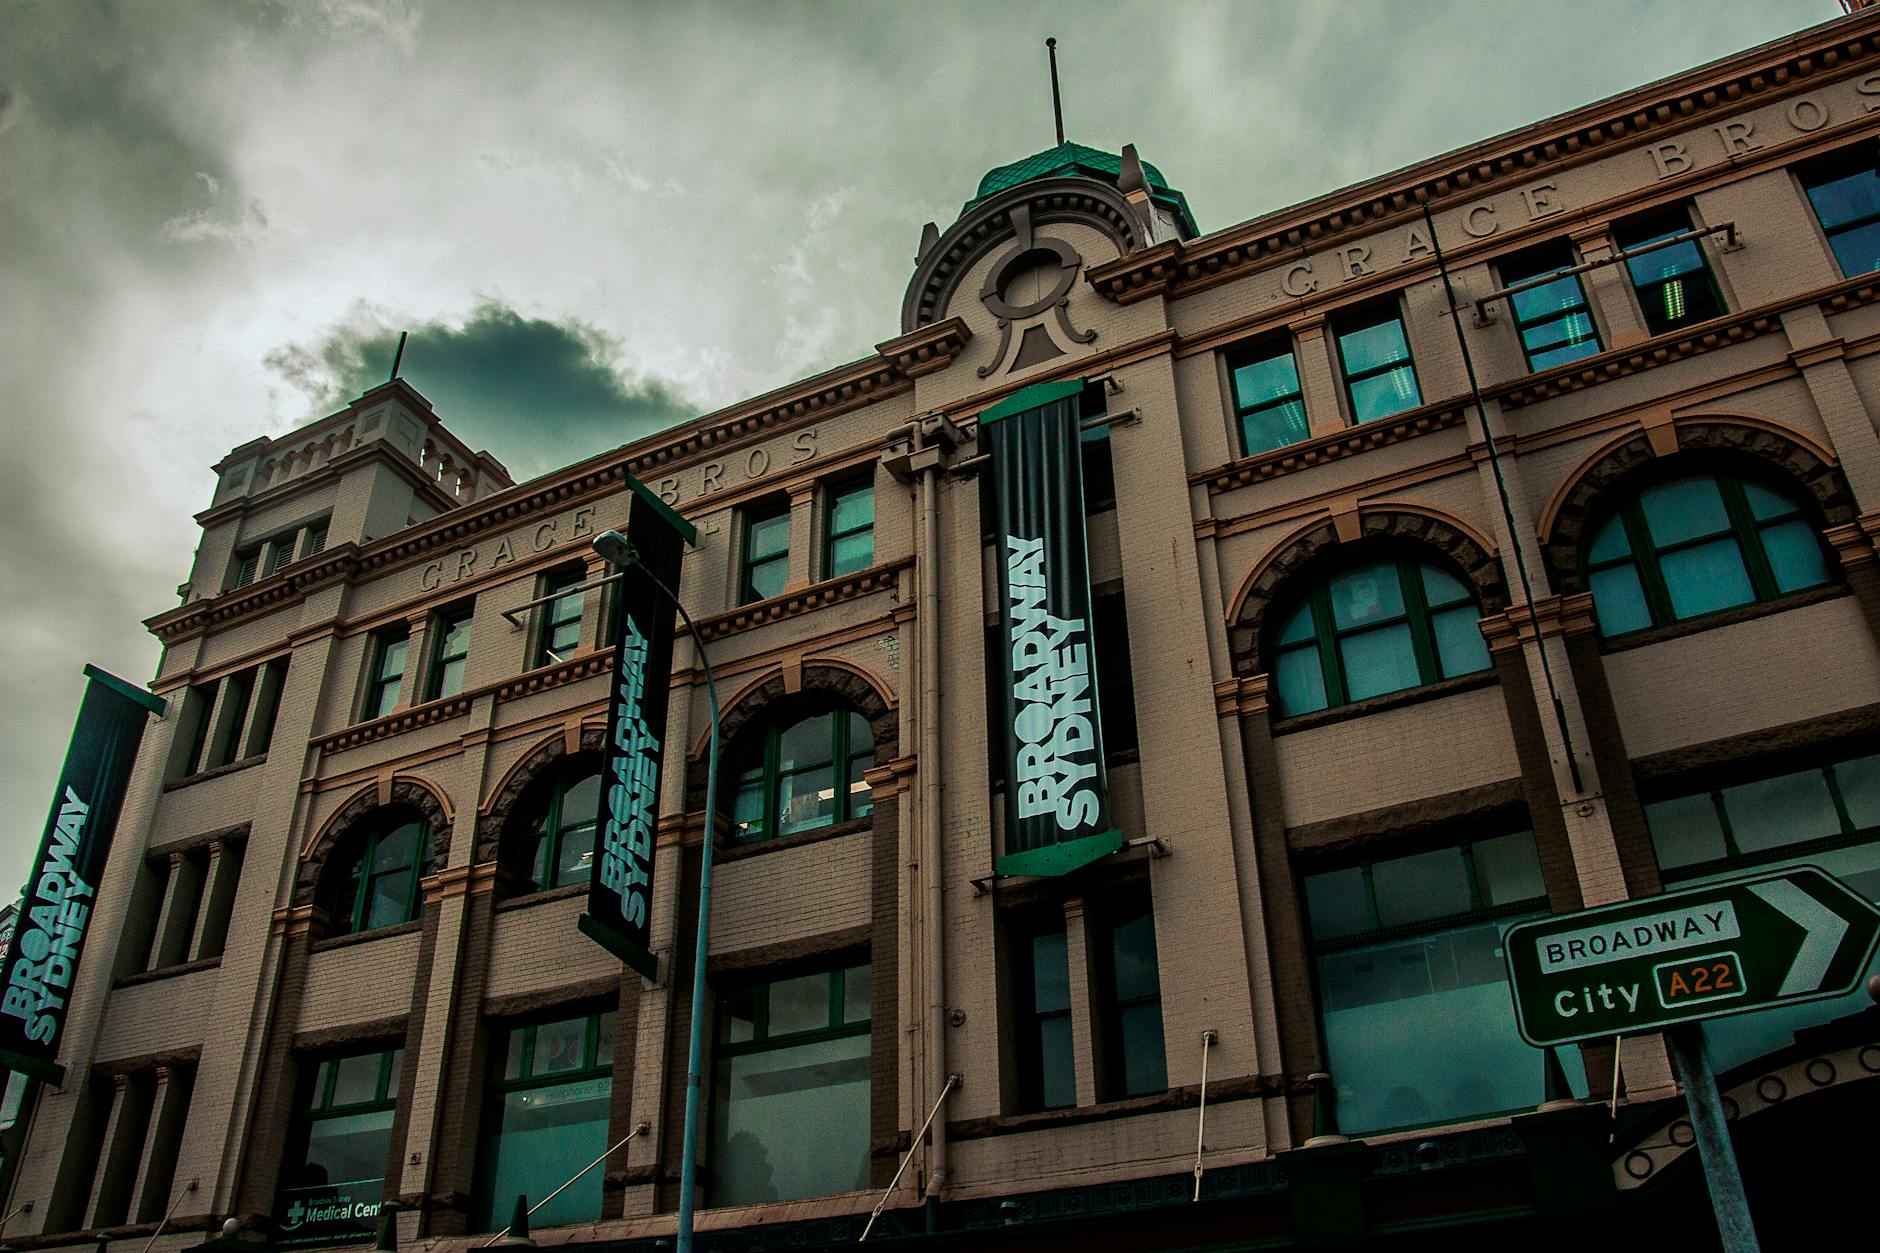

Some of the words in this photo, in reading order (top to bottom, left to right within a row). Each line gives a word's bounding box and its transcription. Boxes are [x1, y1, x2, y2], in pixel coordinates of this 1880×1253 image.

[1280, 182, 1566, 298] GRACE
[420, 505, 597, 593] GRACE
[656, 429, 820, 505] BROS
[600, 613, 648, 896] BROADWAY
[1006, 534, 1059, 819] BROADWAY
[1049, 613, 1099, 831] SYDNEY
[1, 785, 91, 1021] BROADWAY
[621, 714, 660, 929] SYDNEY
[24, 868, 94, 1046] SYDNEY
[1546, 910, 1725, 965] BROADWAY
[1554, 982, 1640, 1018] City
[1669, 963, 1734, 998] A22
[306, 1203, 352, 1223] Medical
